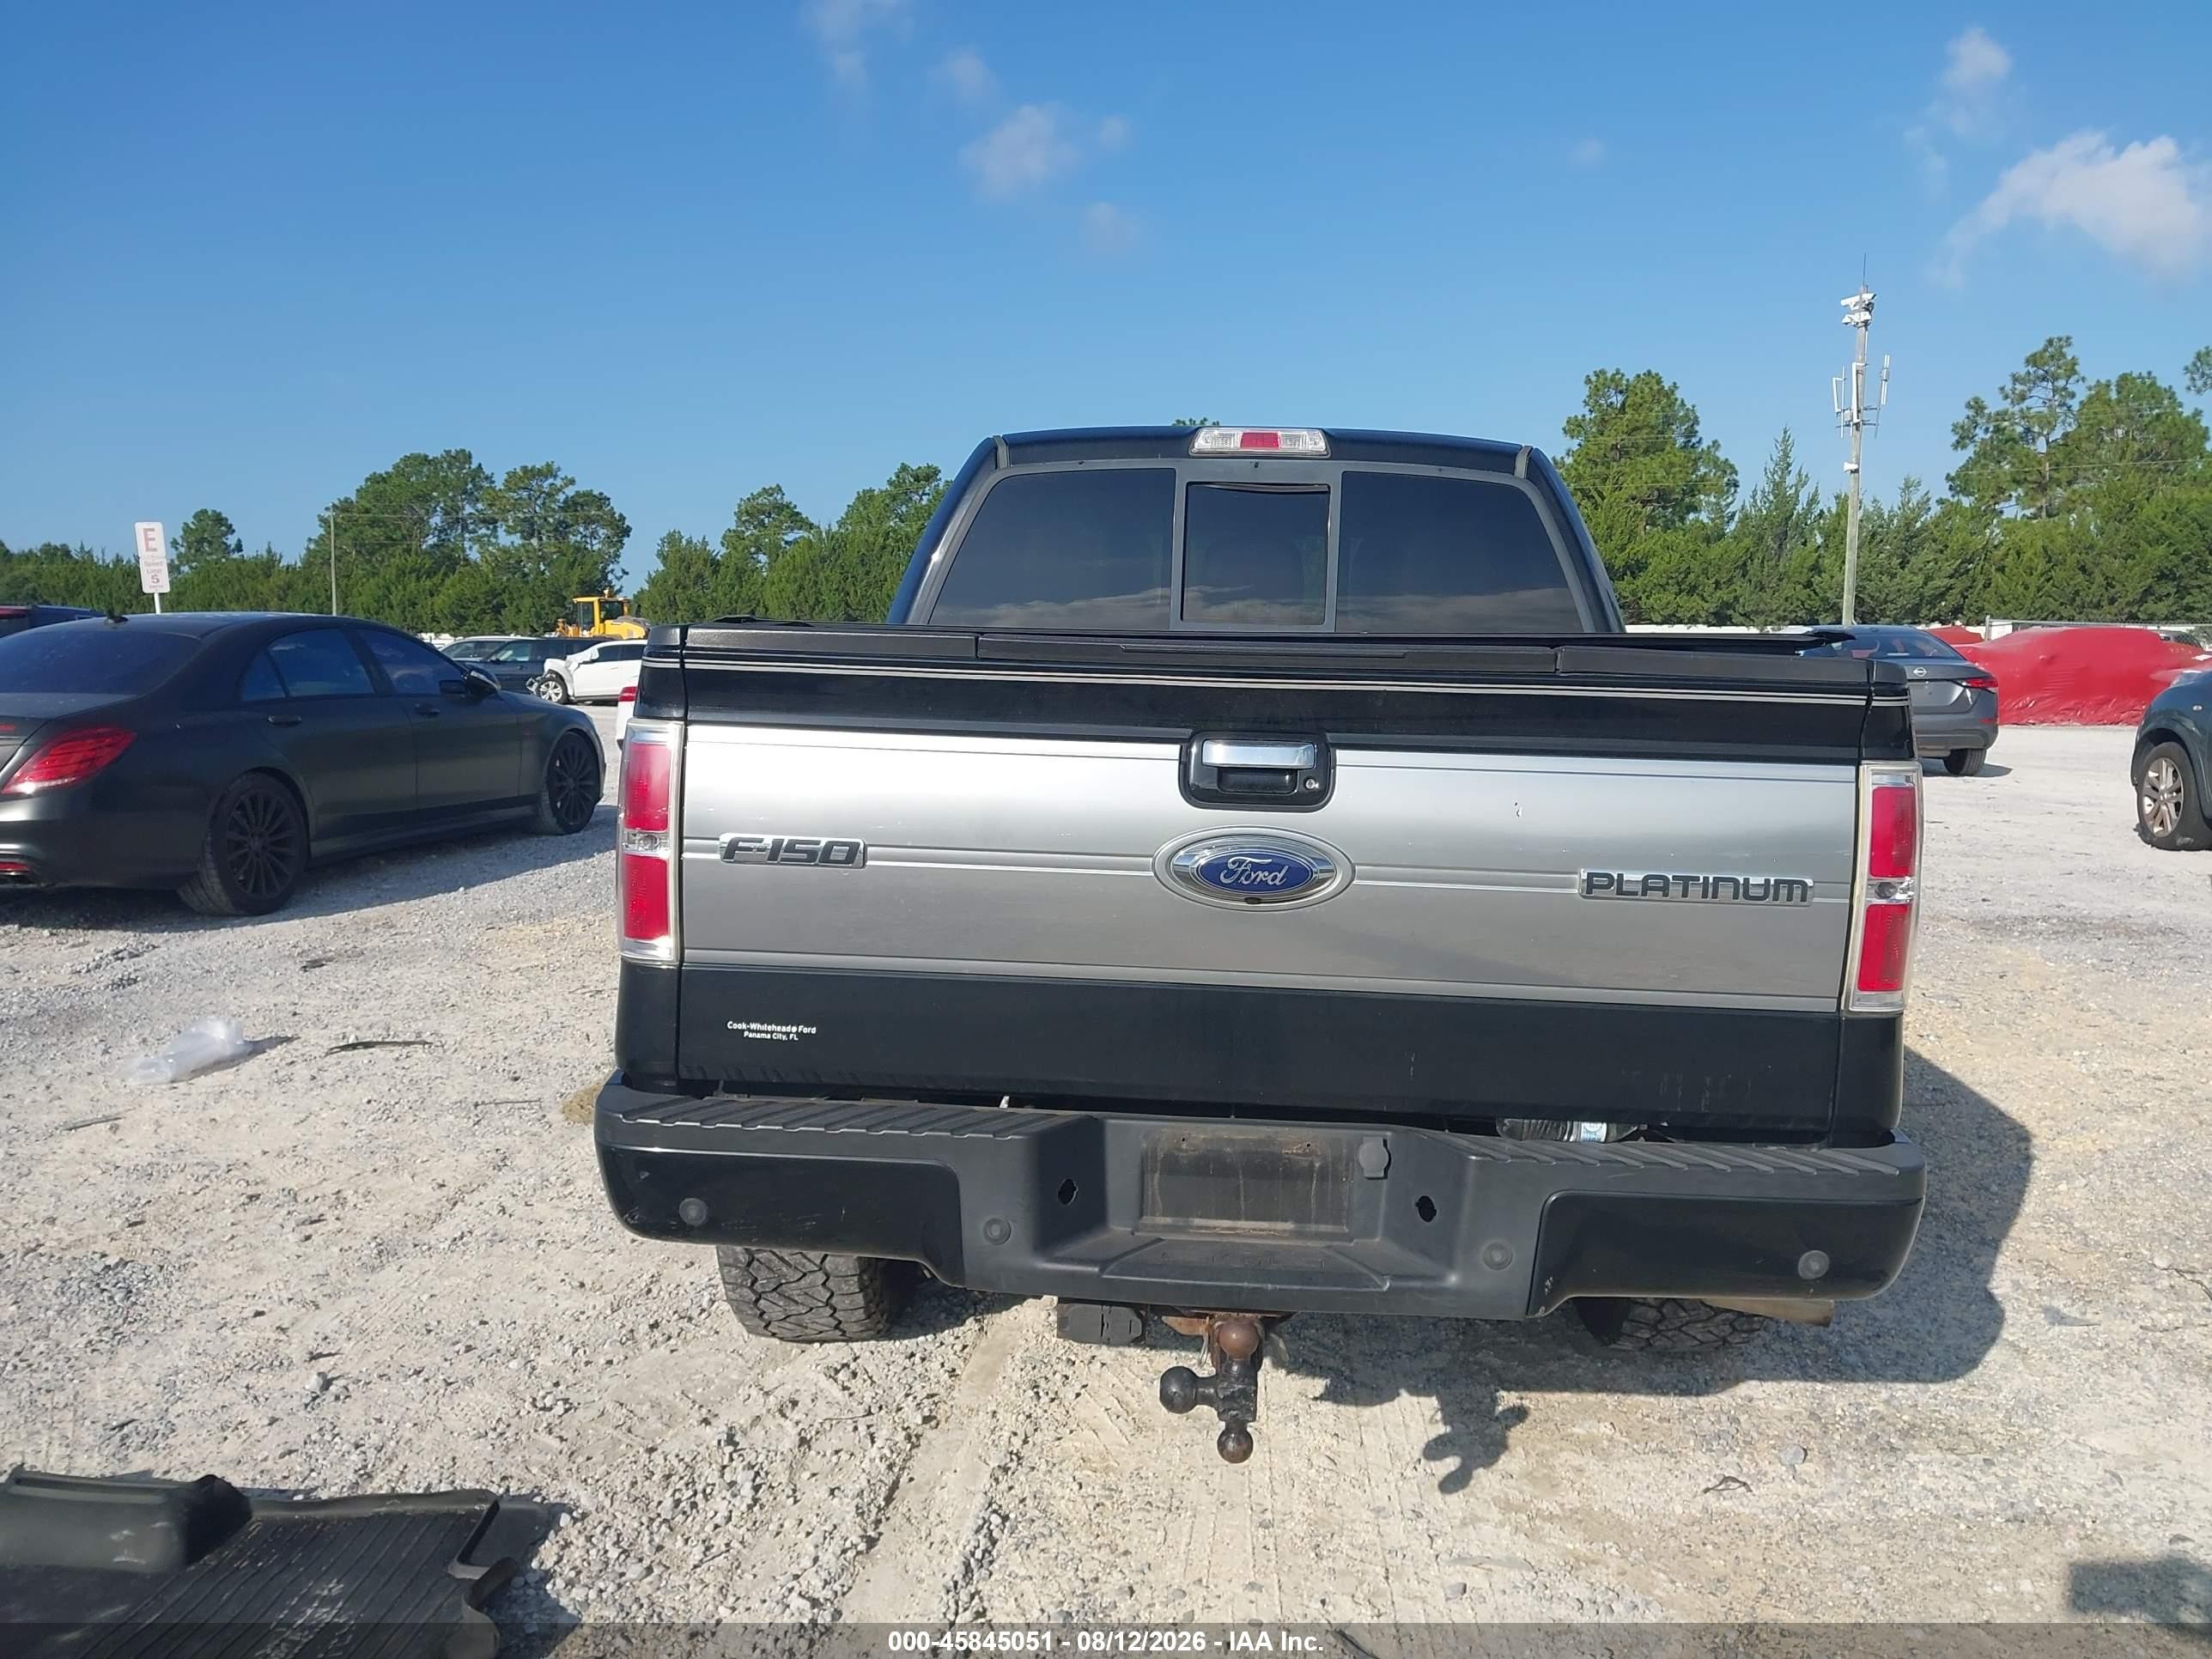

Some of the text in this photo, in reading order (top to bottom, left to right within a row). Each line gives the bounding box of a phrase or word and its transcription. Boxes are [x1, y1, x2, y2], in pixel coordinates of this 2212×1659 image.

[143, 527, 158, 552] E
[150, 574, 161, 584] 5
[723, 837, 860, 865] F-150
[1219, 856, 1289, 885] Ford
[1585, 872, 1808, 902] PLATINUM
[743, 1030, 771, 1040] Panama
[798, 1024, 817, 1034] Ford
